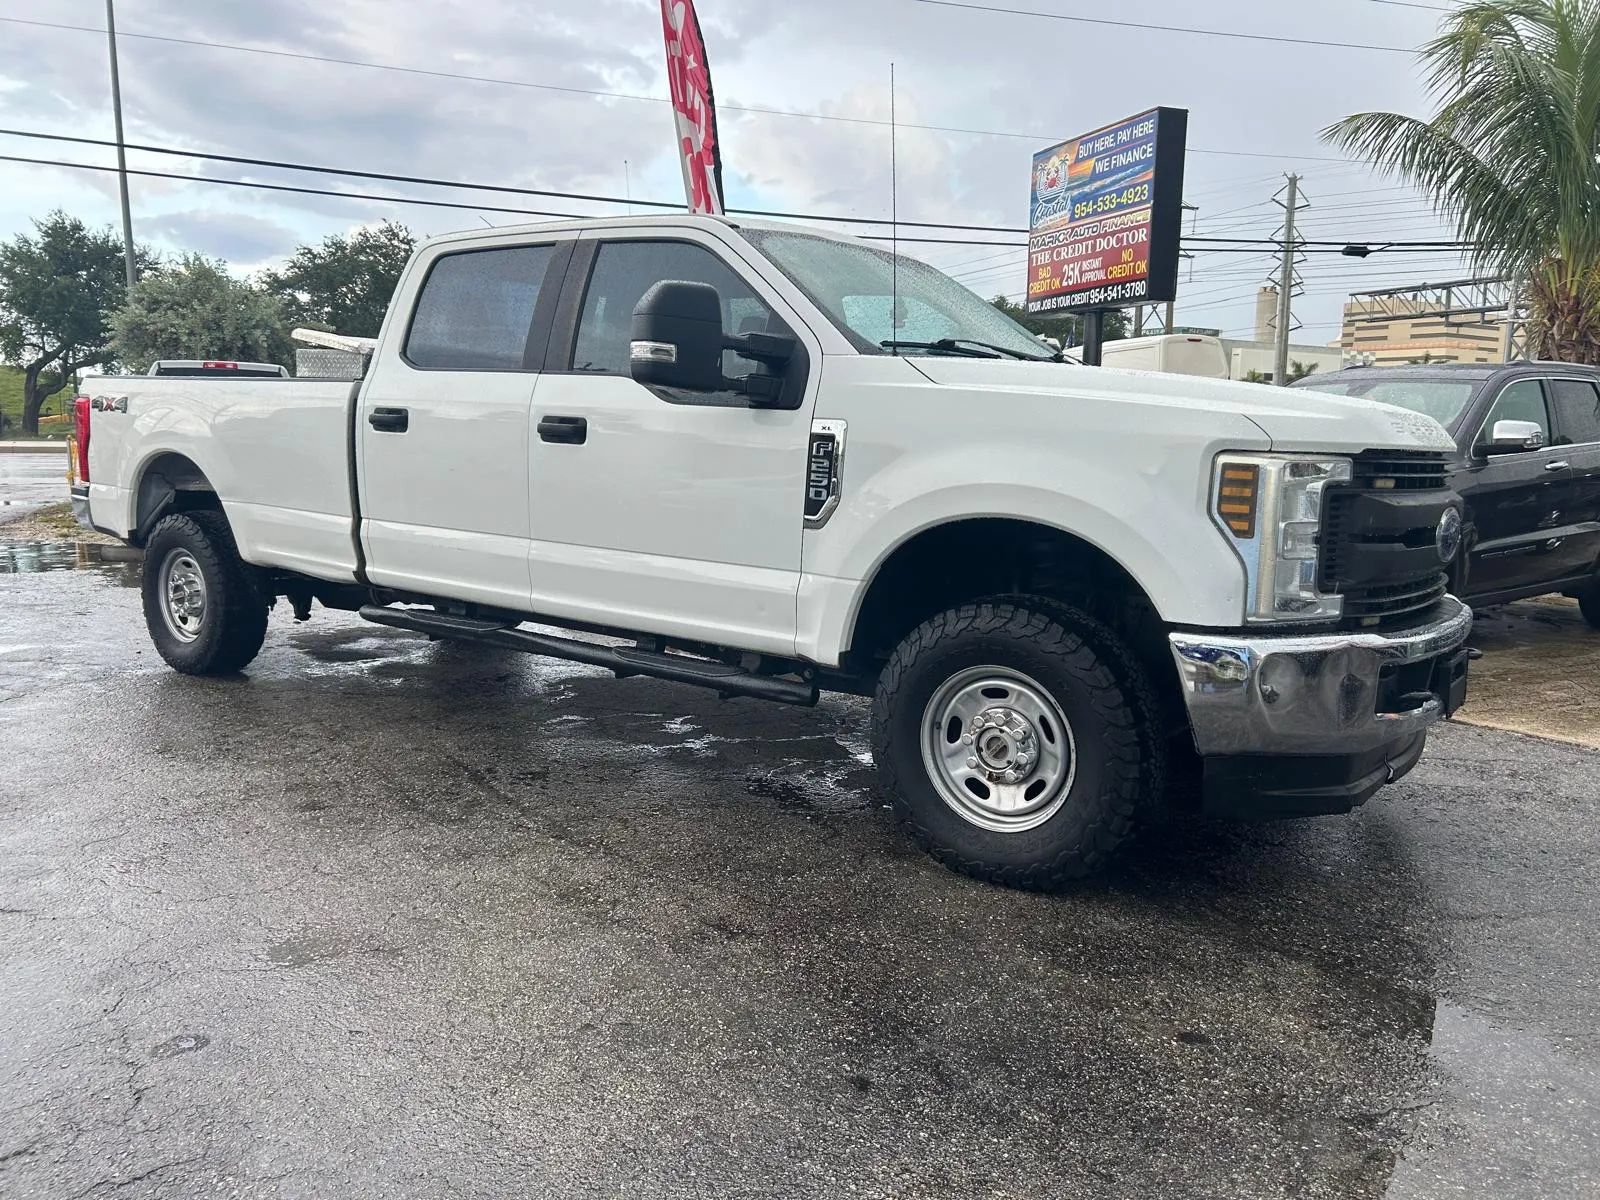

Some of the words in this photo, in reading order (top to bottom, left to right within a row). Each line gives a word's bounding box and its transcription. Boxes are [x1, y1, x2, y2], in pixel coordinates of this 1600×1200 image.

[1079, 141, 1094, 158] BUY
[1117, 128, 1132, 145] PAY
[1133, 119, 1154, 138] HERE
[1095, 158, 1110, 174] WE
[1111, 143, 1153, 168] FINANCE
[1033, 194, 1070, 225] Coastal
[1074, 184, 1149, 218] 954-533-4923
[1071, 222, 1100, 241] AUTO
[1100, 209, 1151, 233] FINANCE
[1032, 250, 1051, 266] THE
[1053, 240, 1094, 262] CREDIT
[1096, 228, 1147, 251] DOCTOR
[1121, 248, 1134, 262] NO
[1038, 266, 1051, 279] BAD
[1062, 261, 1081, 287] 25K
[1081, 257, 1103, 271] INSTANT
[1081, 269, 1106, 283] APPROVAL
[1107, 263, 1134, 279] CREDIT
[1135, 260, 1147, 274] OK
[1028, 301, 1040, 312] YOUR
[1041, 299, 1051, 310] JOB
[1052, 298, 1057, 308] IS
[1057, 296, 1071, 307] YOUR
[1071, 292, 1090, 305] CREDIT
[1090, 280, 1146, 304] 954-541-3780
[1029, 279, 1050, 294] CREDIT
[1051, 277, 1061, 290] OK
